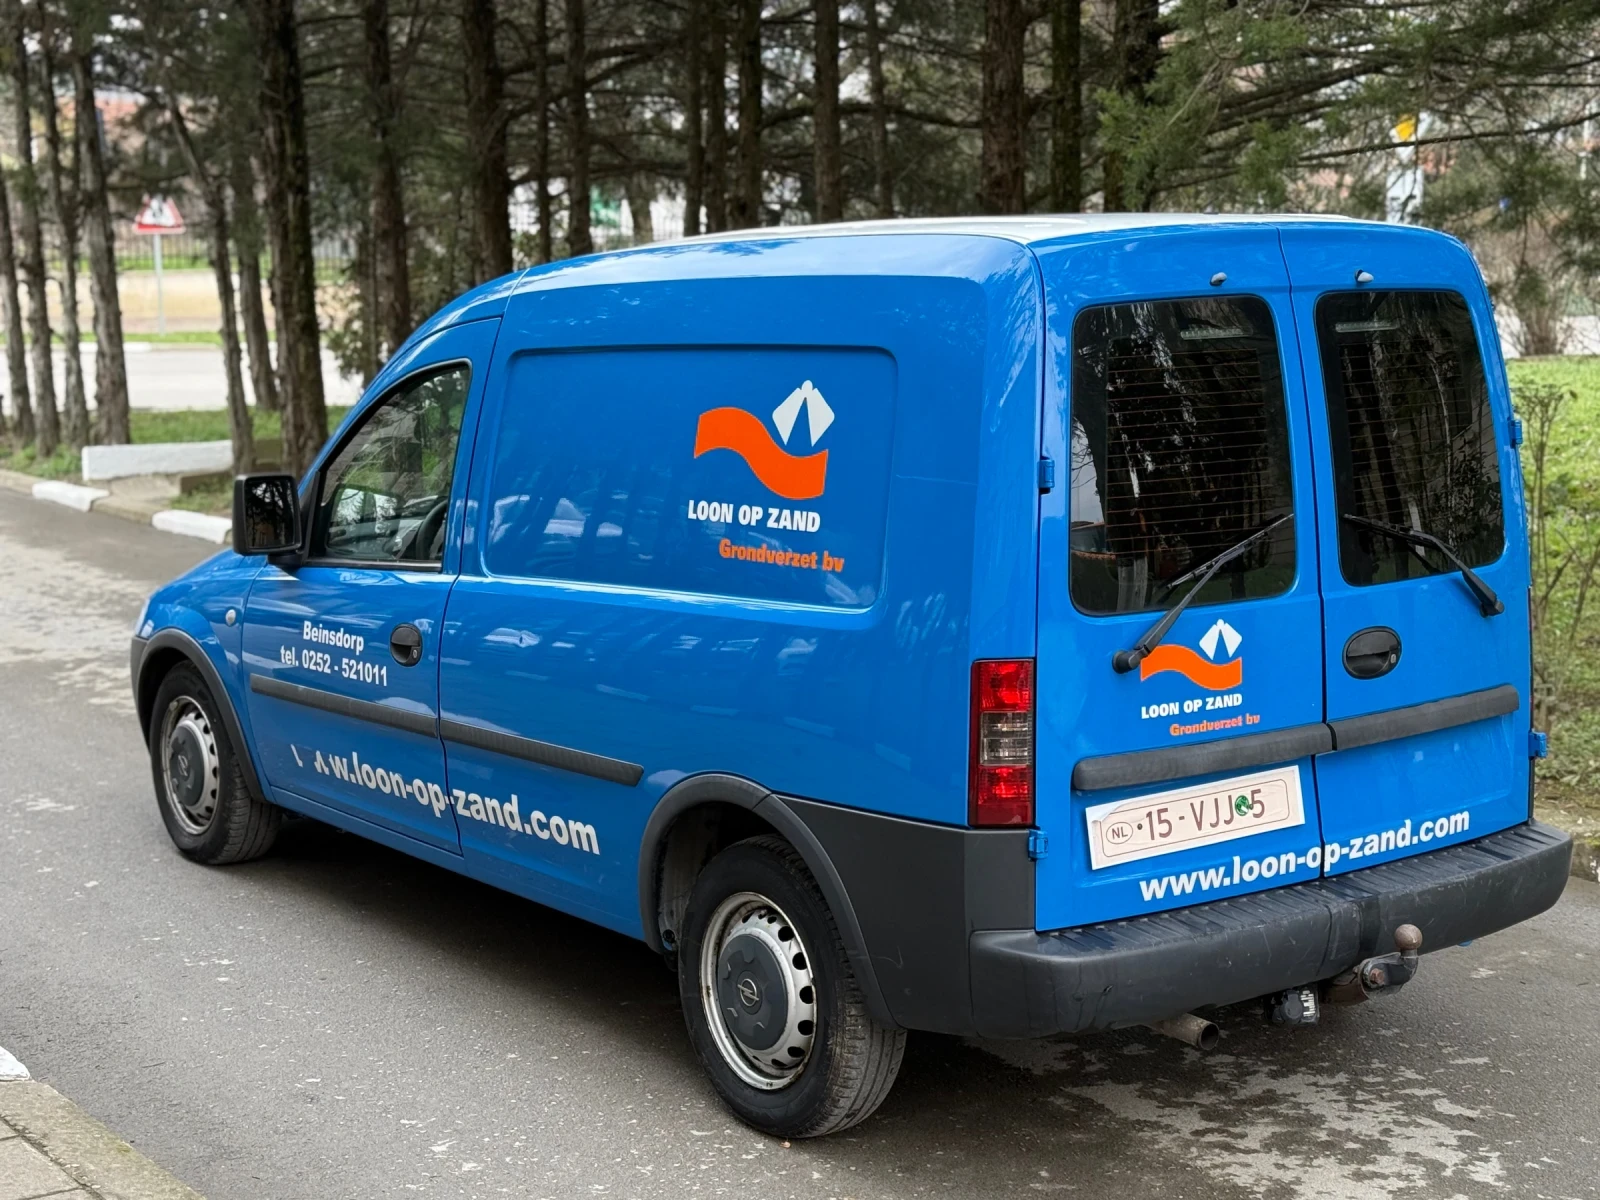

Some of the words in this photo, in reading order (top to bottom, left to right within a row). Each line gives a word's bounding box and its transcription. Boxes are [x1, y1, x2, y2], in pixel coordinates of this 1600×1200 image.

[688, 500, 733, 523] LOON
[738, 504, 763, 526] OP
[767, 508, 821, 532] ZAND
[719, 538, 818, 569] Grondverzet
[822, 550, 845, 572] bv
[303, 620, 364, 655] Beinsdorp
[280, 645, 299, 666] tel.
[302, 649, 331, 674] 0252
[341, 658, 387, 686] 521011
[1141, 702, 1179, 719] LOON
[1183, 699, 1203, 713] OP
[1205, 693, 1242, 710] ZAND
[1169, 715, 1242, 736] Grondverzet
[1246, 713, 1260, 725] bv
[290, 743, 600, 855] w.loon-op-zand.com
[1145, 788, 1265, 841] 15-VJJ5
[1111, 826, 1128, 840] NL
[1139, 810, 1470, 901] www.loon-op-zand.com
